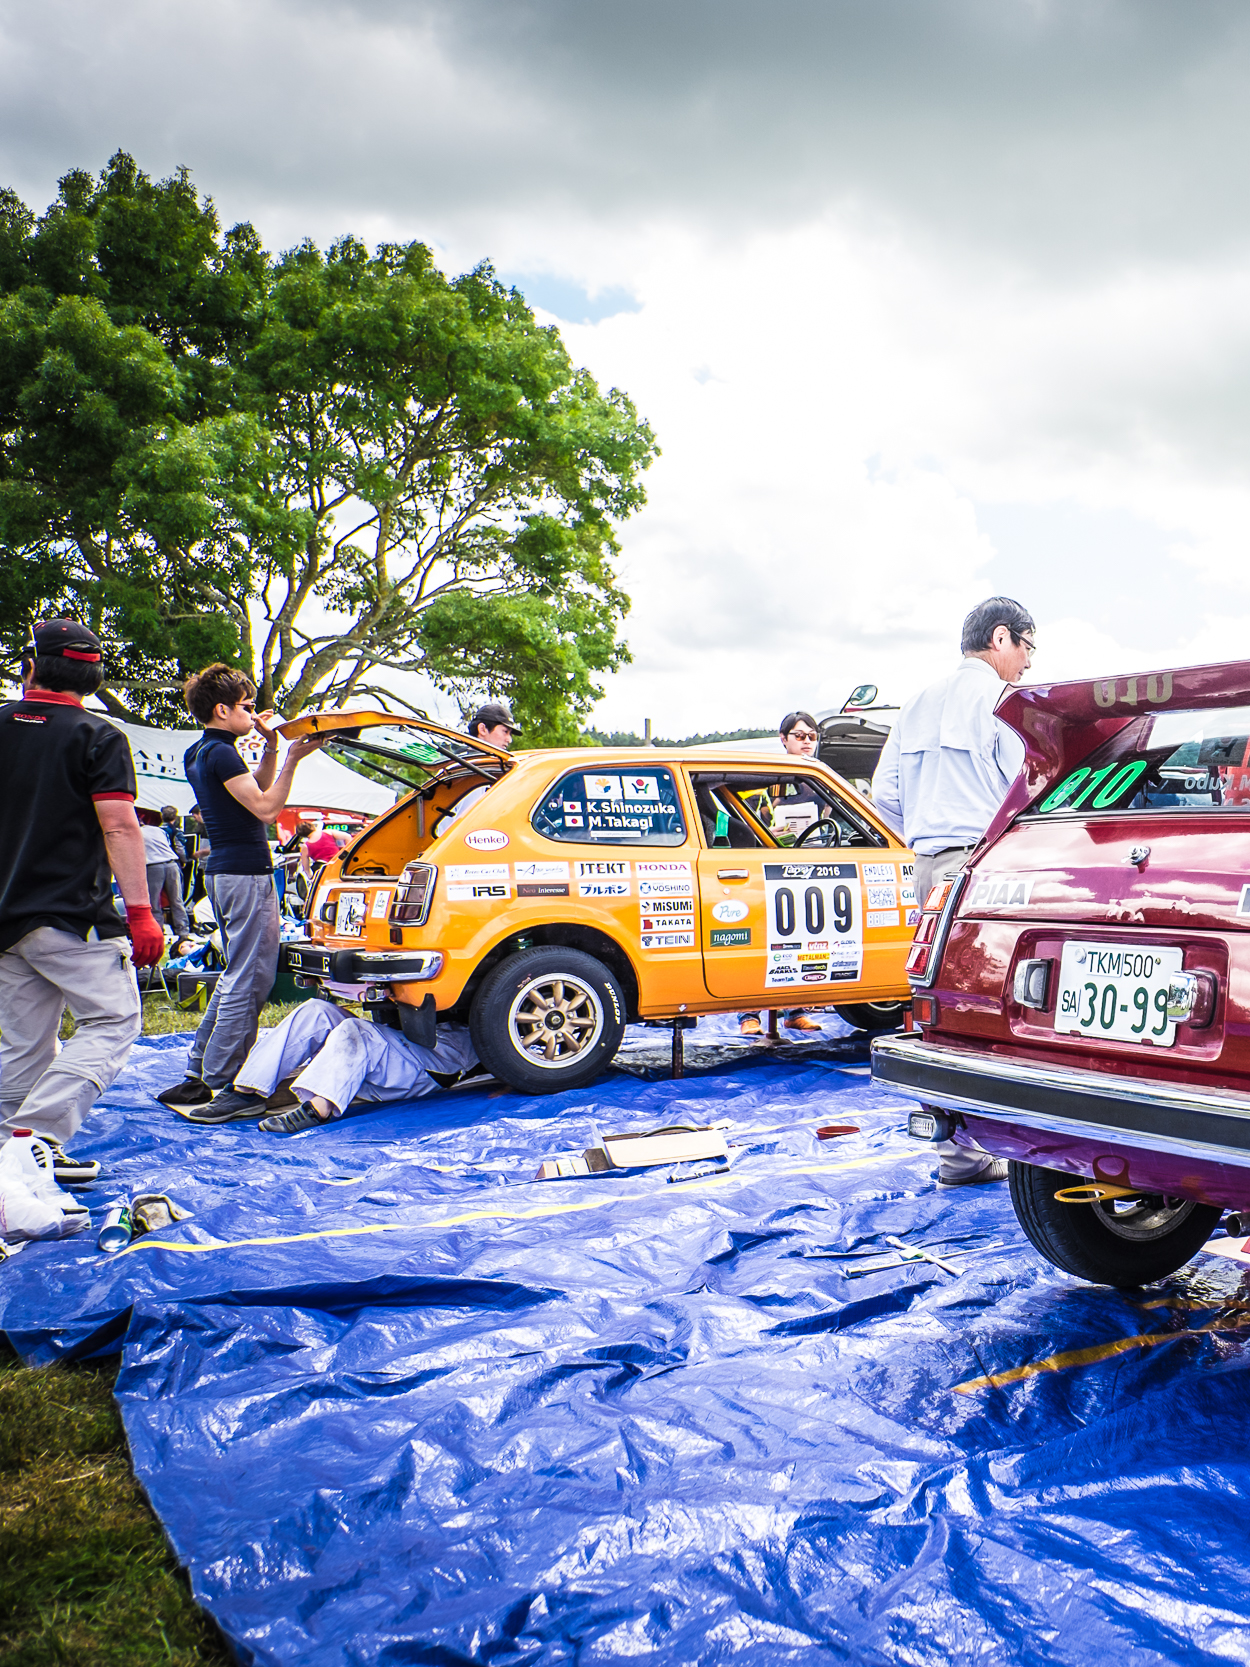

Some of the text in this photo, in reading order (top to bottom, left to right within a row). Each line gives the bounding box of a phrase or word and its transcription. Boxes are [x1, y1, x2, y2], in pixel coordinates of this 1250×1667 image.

[1039, 760, 1148, 812] 010
[586, 801, 676, 814] K.Shinozuka
[588, 816, 653, 830] M.Takagi
[468, 836, 506, 844] Henkel
[580, 863, 626, 876] JTEKT
[816, 866, 840, 876] 2016
[864, 865, 893, 876] ENDLESS
[472, 886, 507, 897] IRS
[580, 884, 628, 895] ブルボン
[652, 884, 690, 892] YOSHINO
[974, 882, 1026, 905] PIAA
[775, 885, 853, 936] 009
[655, 935, 691, 945] TEIN
[713, 931, 749, 945] nagomi
[1087, 950, 1154, 979] TKM 500
[603, 982, 621, 1025] DUNLOP
